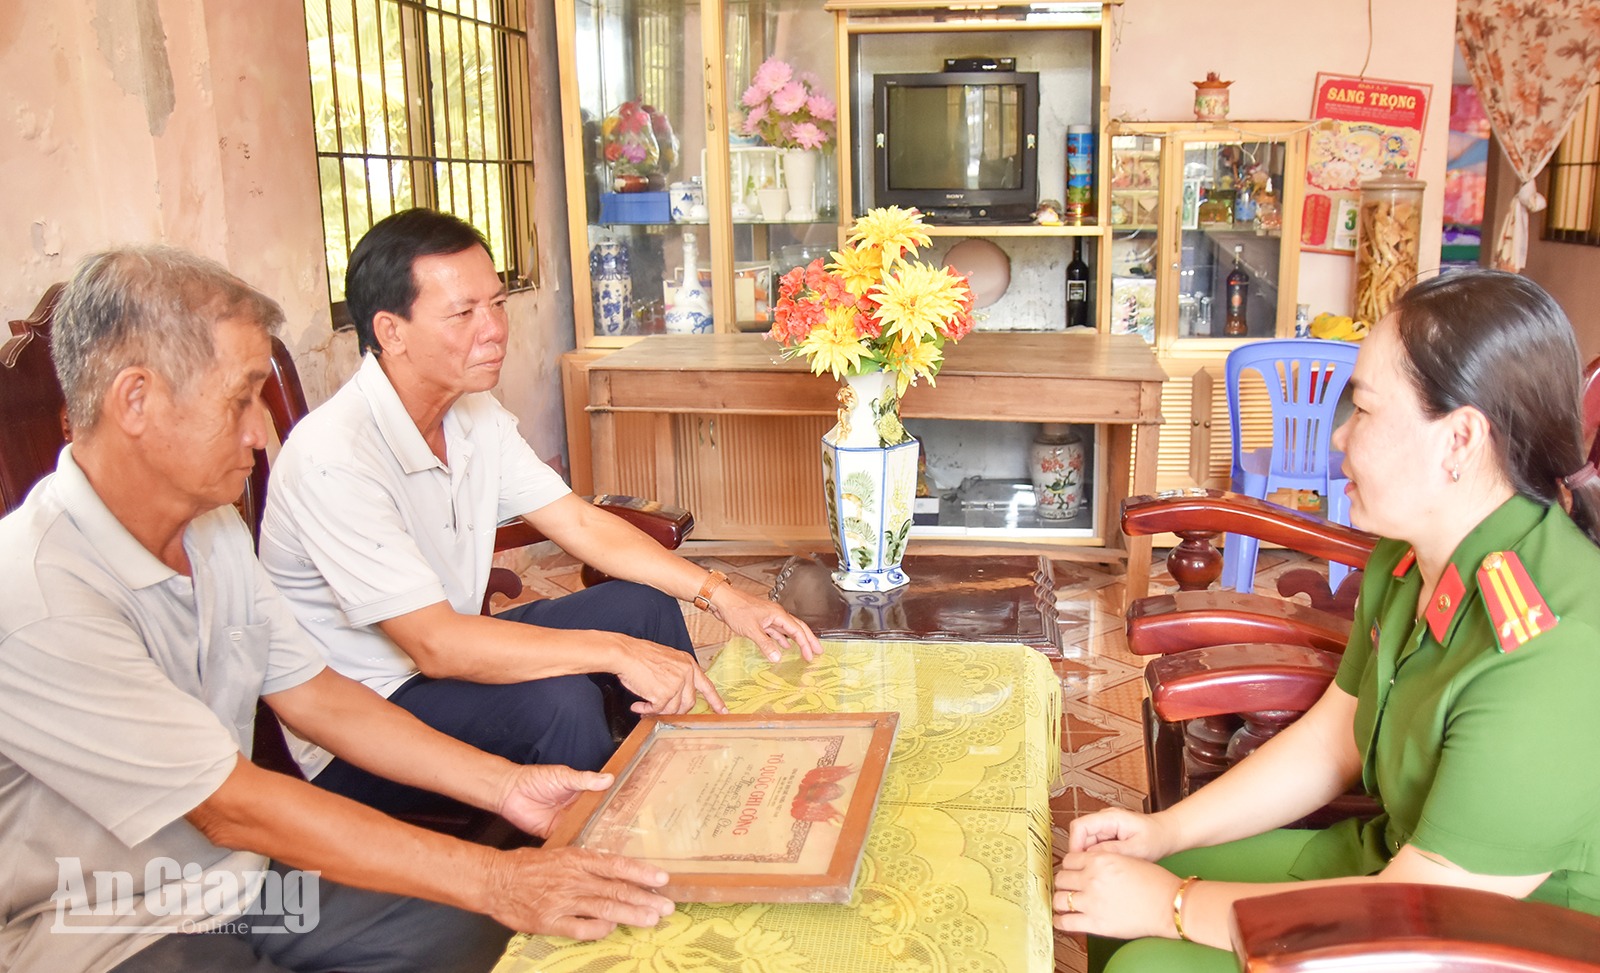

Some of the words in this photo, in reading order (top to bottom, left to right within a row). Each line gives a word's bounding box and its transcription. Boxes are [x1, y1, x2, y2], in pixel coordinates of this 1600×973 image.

[1327, 87, 1365, 104] SANG
[1370, 92, 1416, 111] TRỌNG
[767, 753, 785, 765] TỔ
[754, 765, 778, 789] QUỐC
[745, 790, 765, 806] GHI
[732, 808, 758, 836] CÔNG
